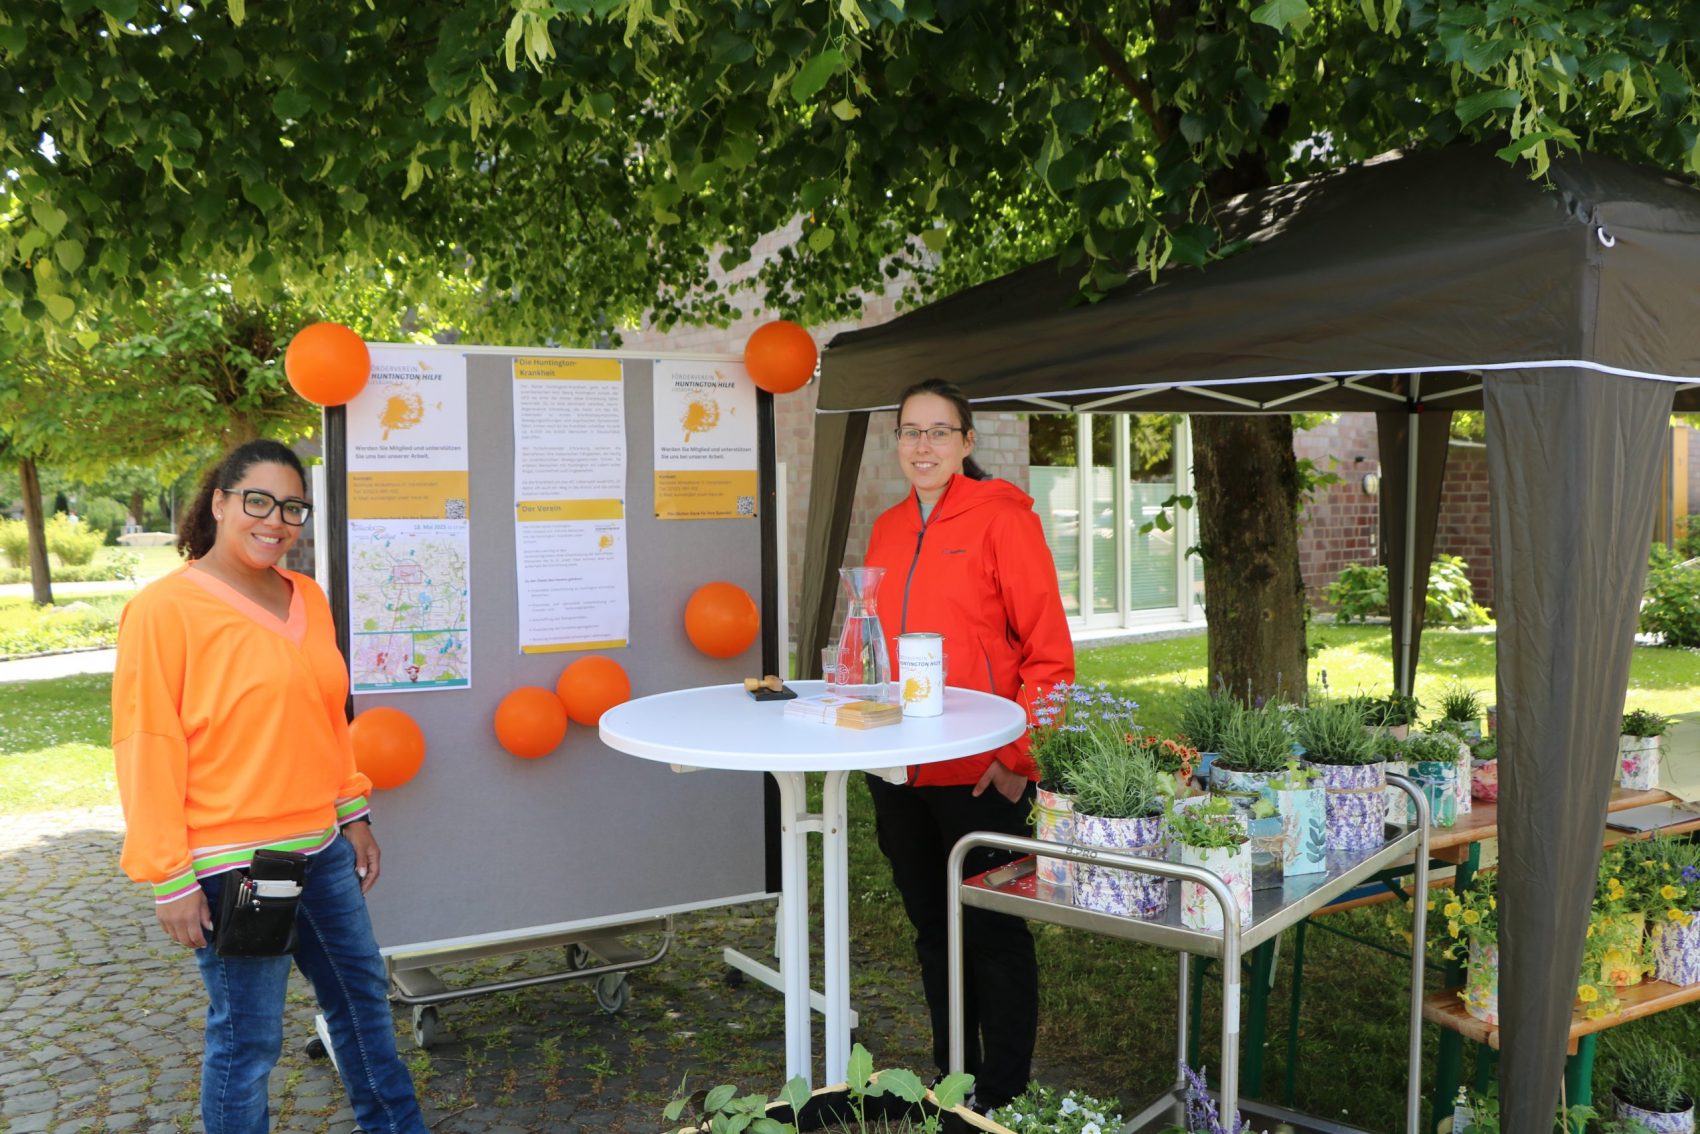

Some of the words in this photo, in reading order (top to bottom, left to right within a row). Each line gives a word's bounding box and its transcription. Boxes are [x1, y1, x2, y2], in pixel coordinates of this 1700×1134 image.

[533, 359, 577, 368] Huntington-
[370, 364, 418, 372] ÖRDERVEREIN
[421, 373, 443, 381] HILFE
[519, 369, 556, 377] Krankheit
[674, 380, 717, 388] HUNTINGTON
[717, 381, 736, 389] HILFE
[521, 505, 535, 513] Der
[537, 504, 562, 512] Verein
